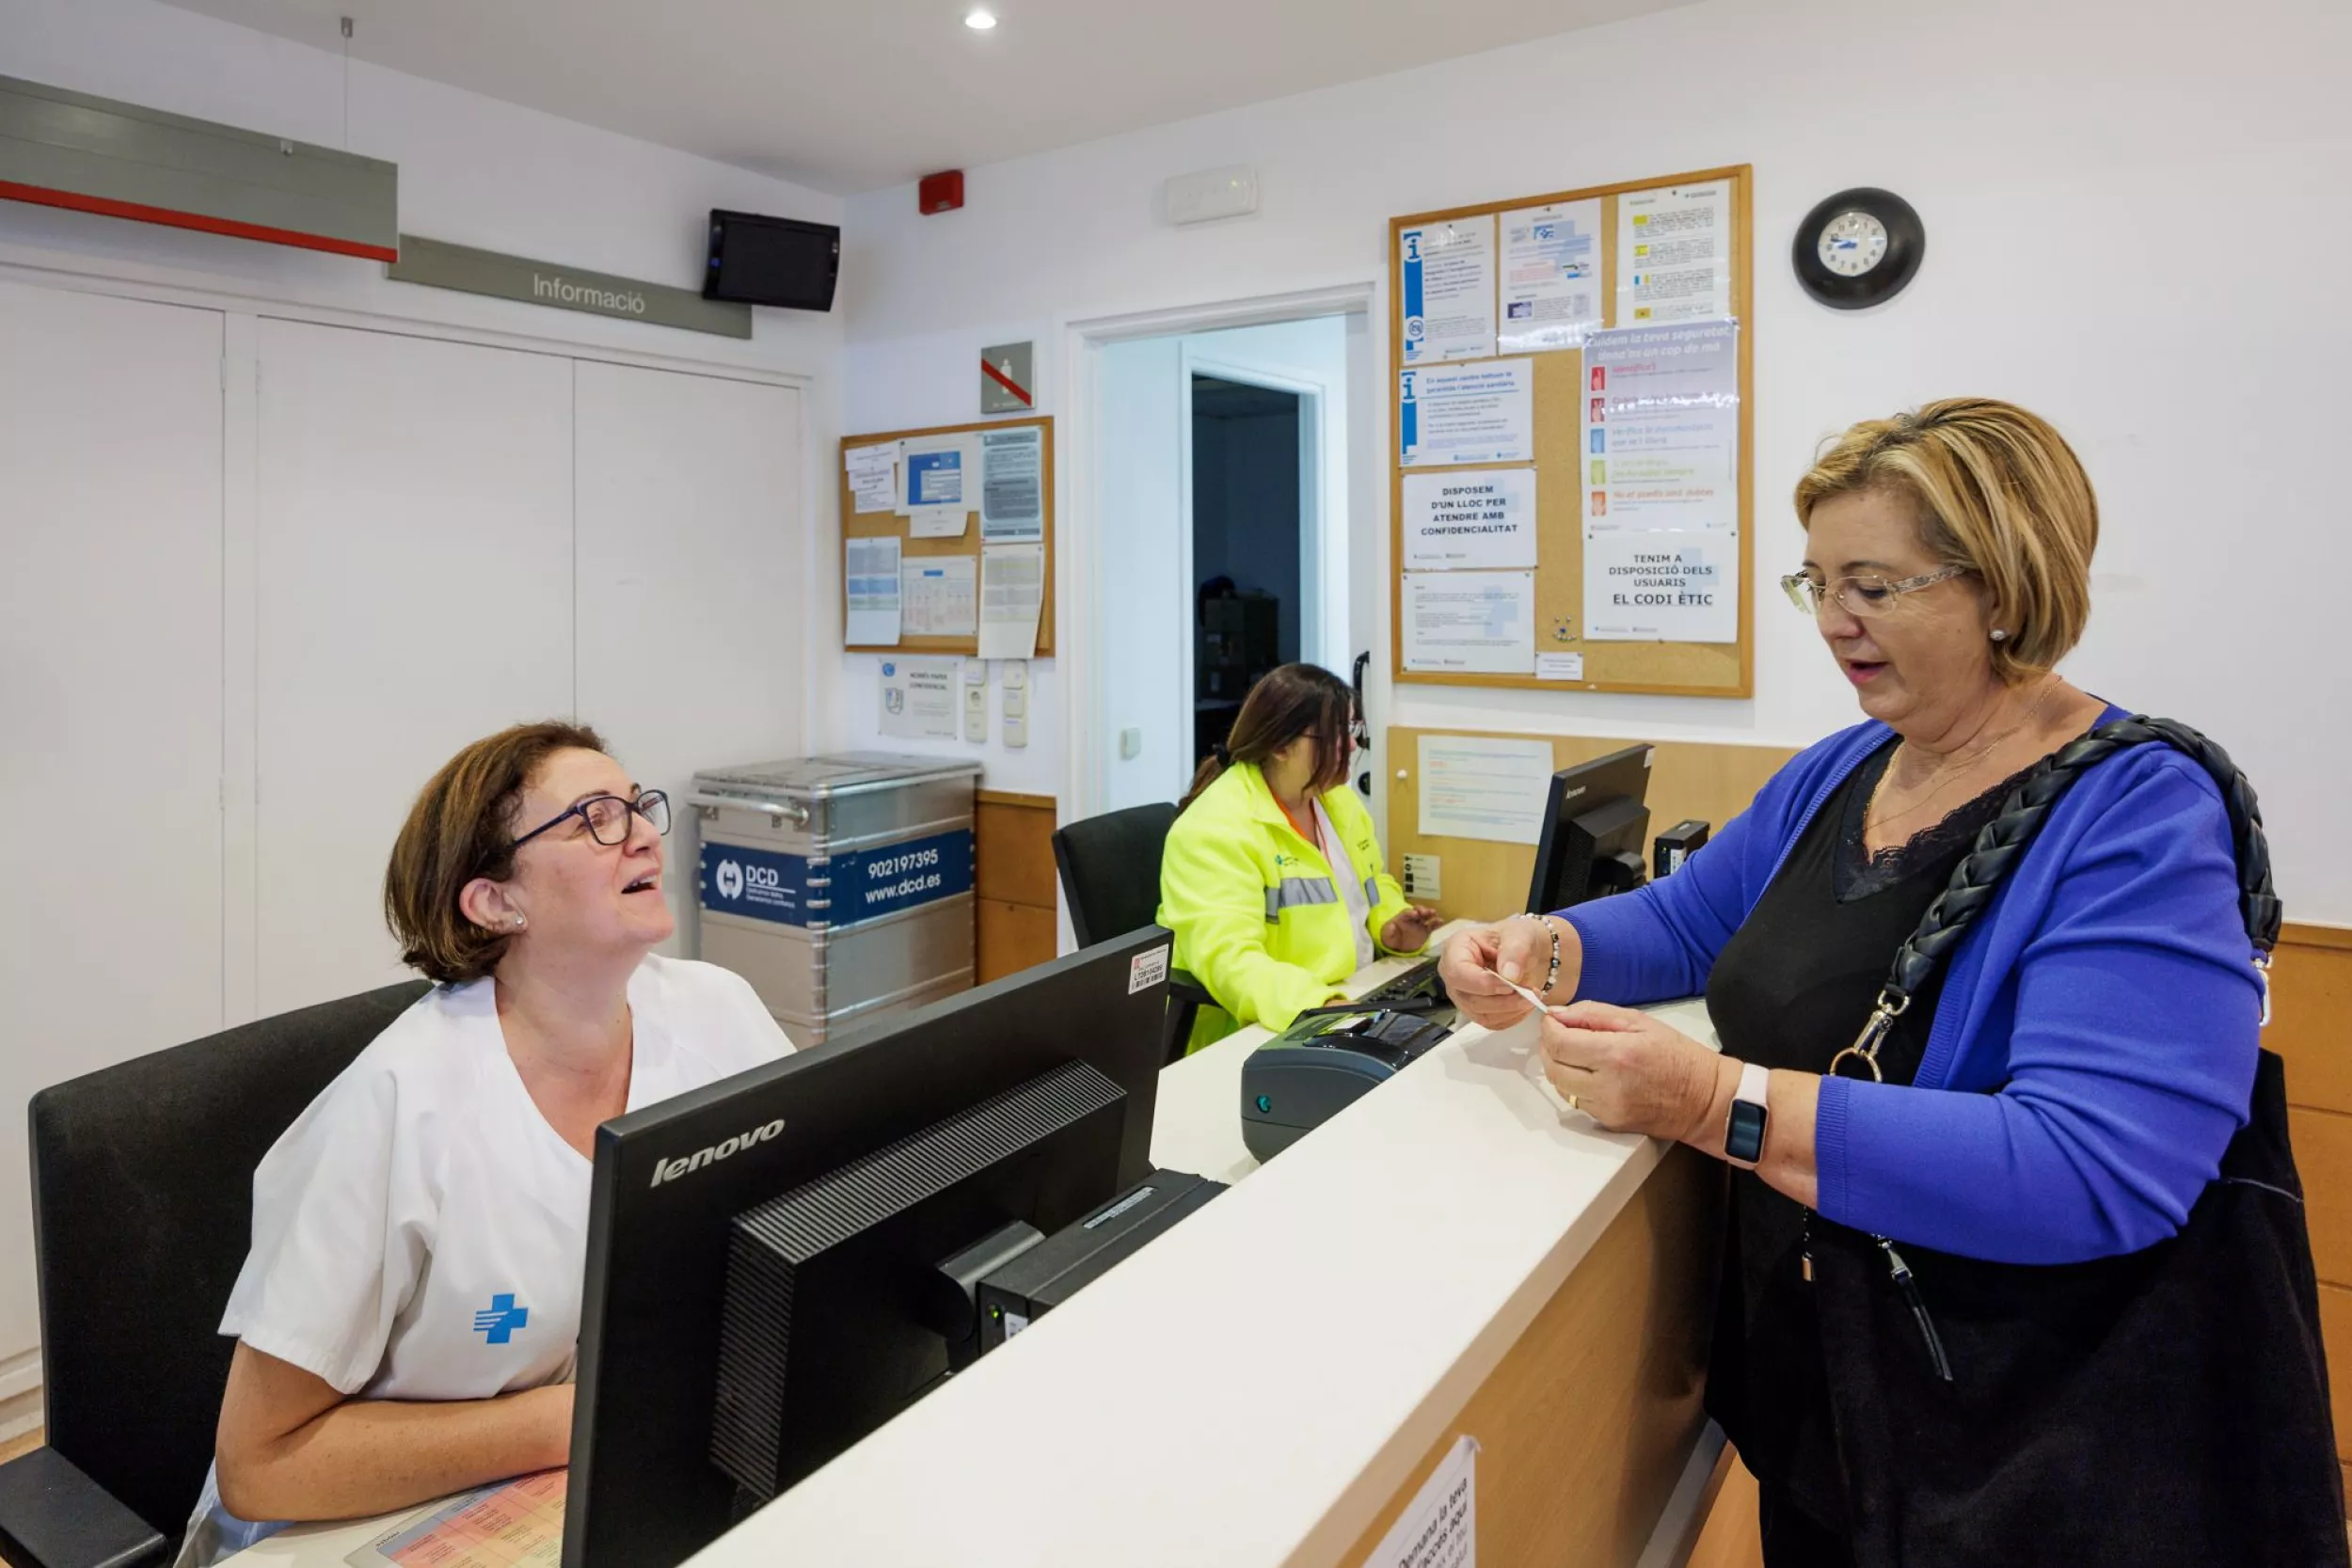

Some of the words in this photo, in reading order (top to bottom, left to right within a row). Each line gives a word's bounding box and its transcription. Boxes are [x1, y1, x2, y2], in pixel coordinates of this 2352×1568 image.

[533, 273, 645, 313] Informació
[1630, 333, 1642, 343] la
[1644, 331, 1669, 342] teva
[1661, 345, 1682, 358] cop
[1684, 342, 1698, 354] de
[1442, 485, 1494, 497] DISPOSEM
[1431, 500, 1454, 510] D'UN
[1457, 499, 1484, 509] LLOC
[1486, 498, 1507, 507] PER
[1433, 512, 1479, 522] ATENDRE
[1483, 511, 1505, 520] AMB
[1421, 524, 1518, 536] CONFIDENCIALITAT
[1633, 554, 1671, 563] TENIM
[1675, 554, 1683, 562] A
[1609, 564, 1680, 576] DISPOSICIÓ
[1683, 565, 1713, 575] DELS
[1633, 578, 1687, 587] USUARIS
[1613, 594, 1629, 605] EL
[1634, 594, 1673, 605] CODI
[1678, 591, 1713, 605] ÈTIC
[867, 848, 939, 879] 902197395
[746, 864, 779, 887] DCD
[865, 873, 941, 905] www.dcd.es
[649, 1118, 786, 1188] lenovo
